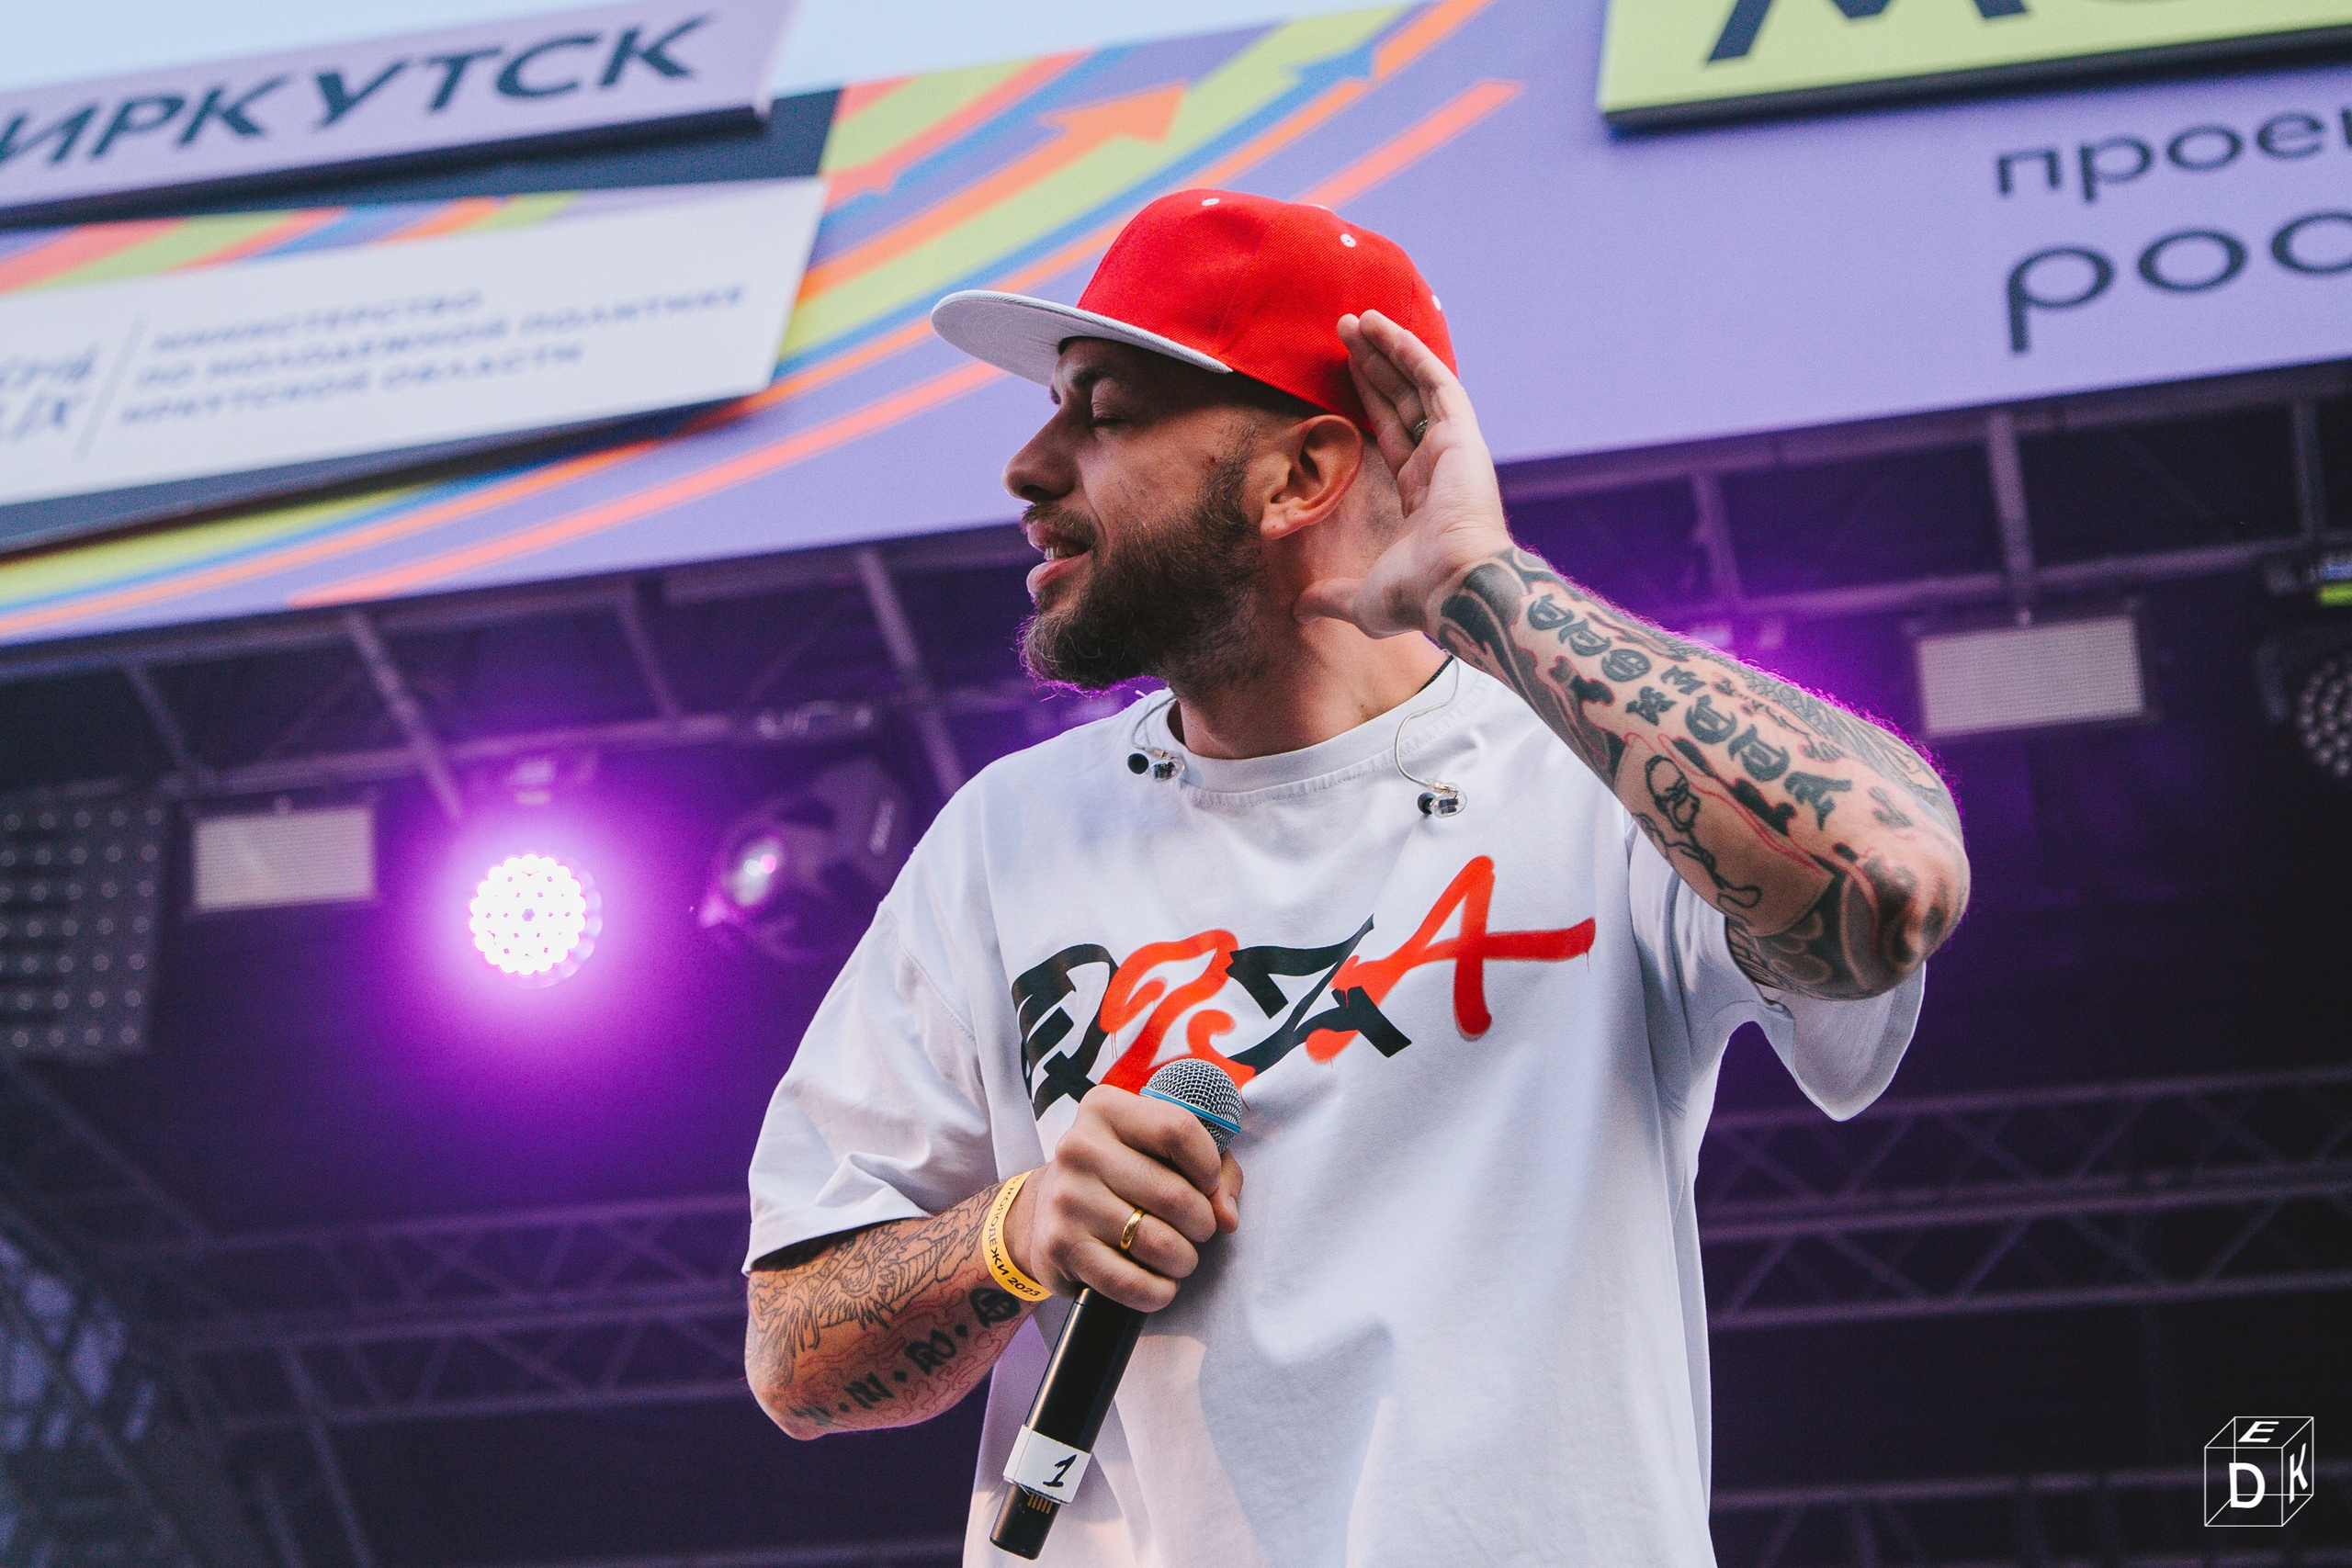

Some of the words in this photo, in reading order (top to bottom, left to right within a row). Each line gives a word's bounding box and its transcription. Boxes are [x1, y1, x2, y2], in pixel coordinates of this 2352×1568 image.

[0, 15, 713, 167] ИРКУТСК
[1997, 109, 2352, 202] прое
[1007, 1277, 1041, 1296] 2023
[1043, 1454, 1077, 1487] 1
